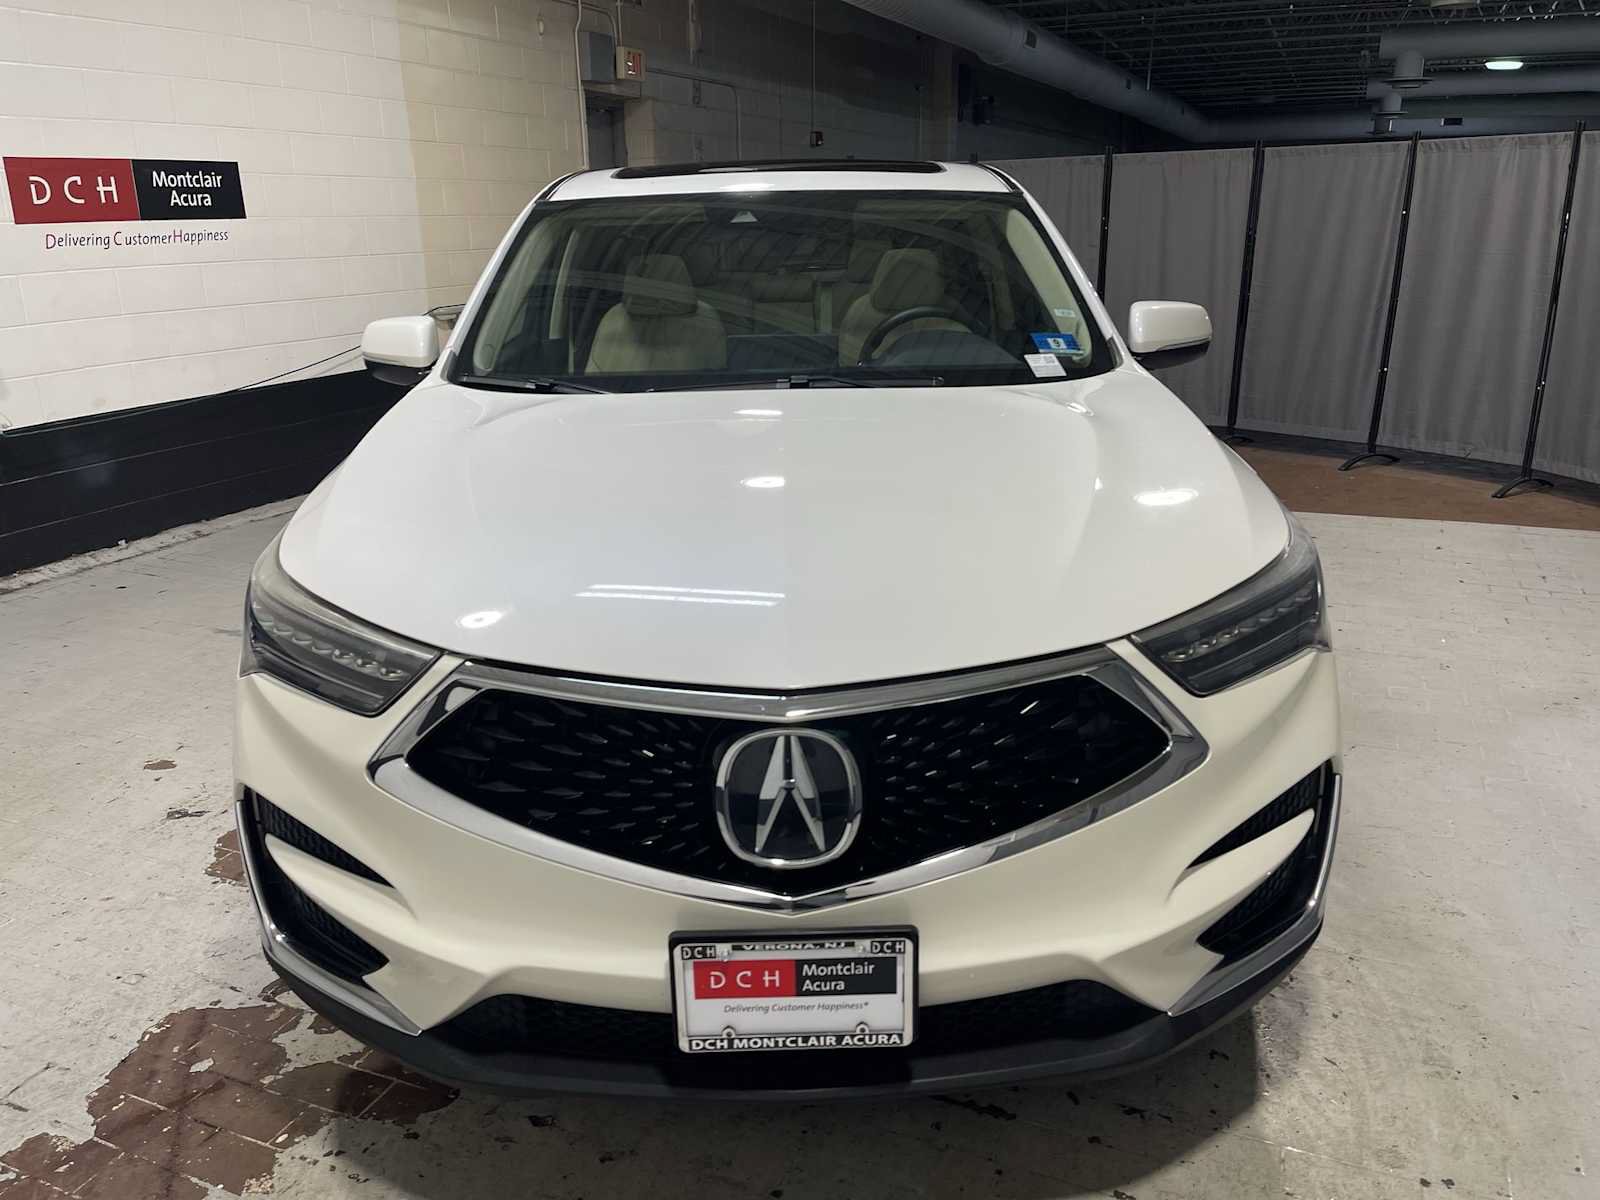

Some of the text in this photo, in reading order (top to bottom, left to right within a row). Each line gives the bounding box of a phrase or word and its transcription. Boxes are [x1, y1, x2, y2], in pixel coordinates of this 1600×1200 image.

[152, 170, 223, 189] Montclair
[170, 190, 213, 207] Acura
[45, 233, 111, 250] Delivering
[802, 961, 875, 977] Montclair
[802, 979, 846, 992] Acura
[723, 1004, 769, 1014] Delivering
[771, 1002, 816, 1012] Customer
[691, 1034, 901, 1050] DCH MONTCLAIR ACURA
